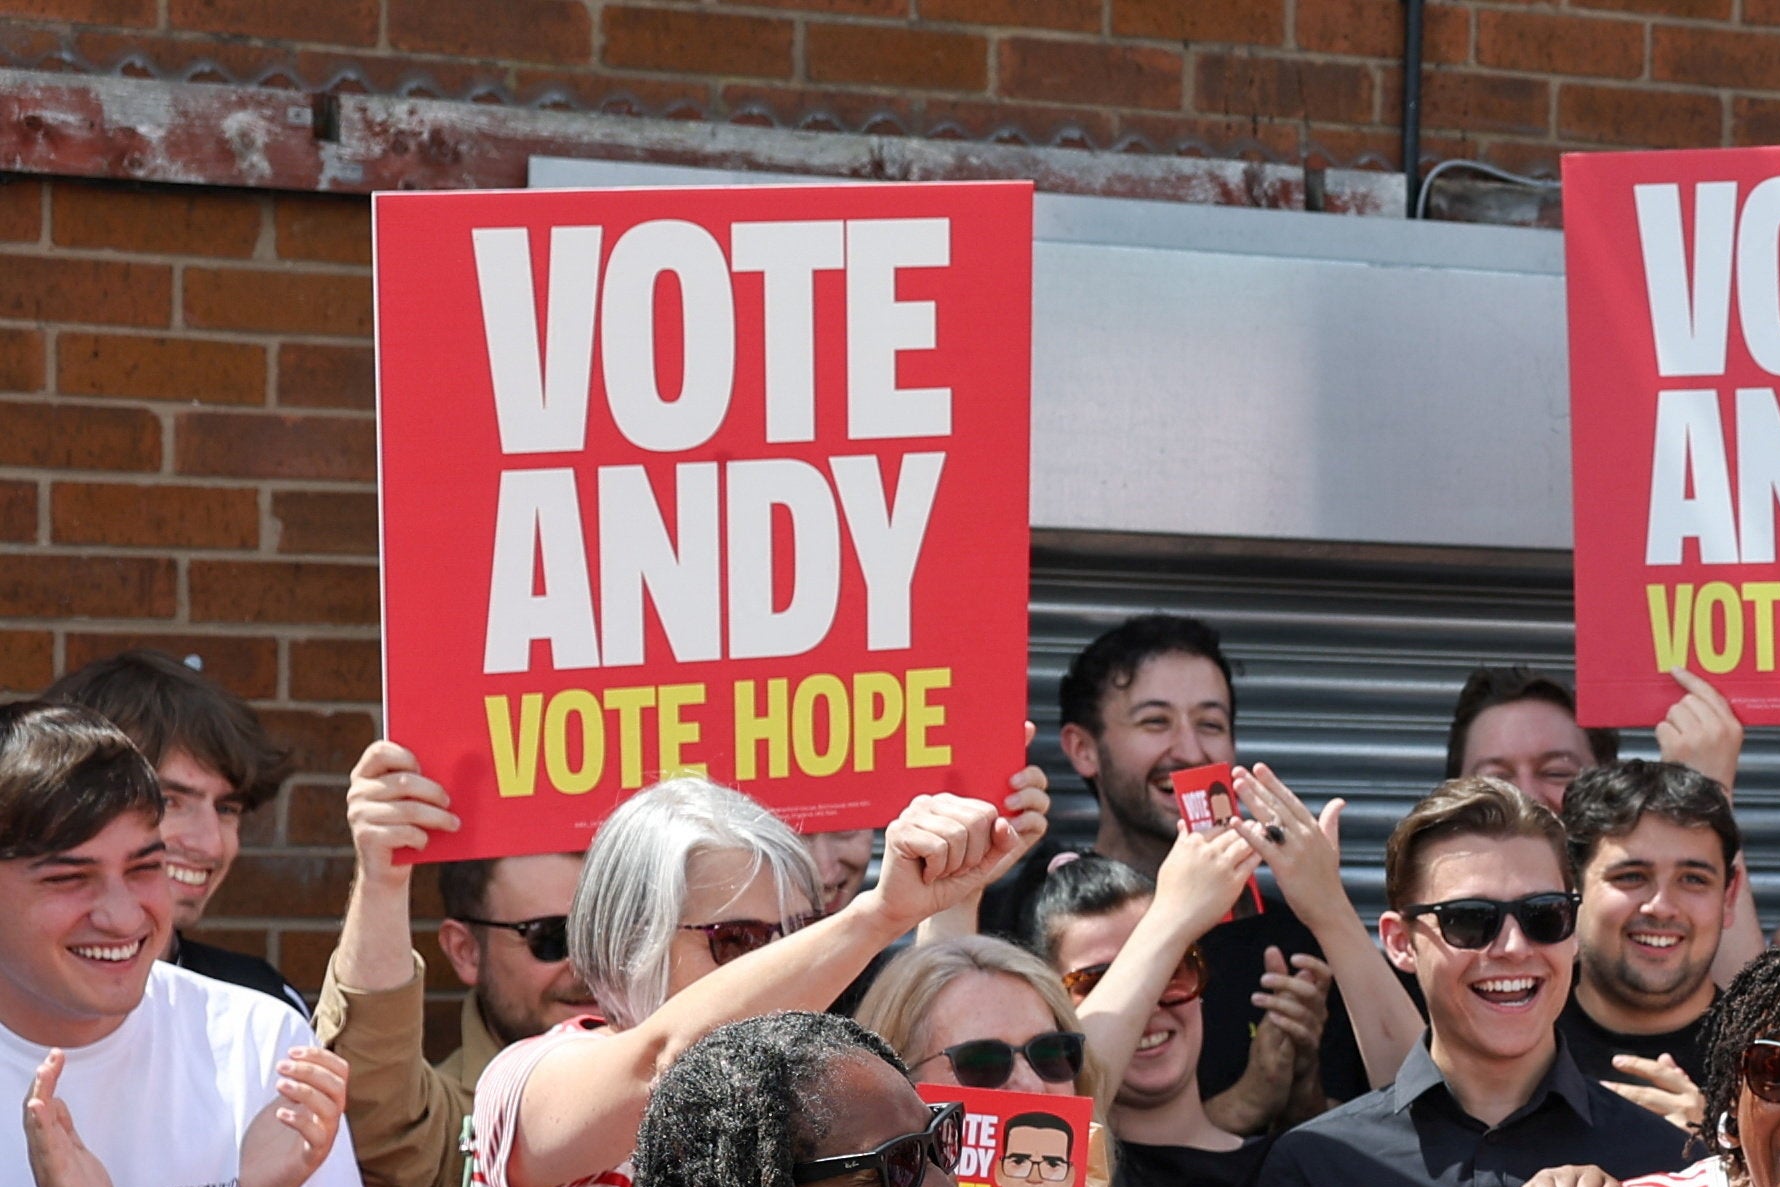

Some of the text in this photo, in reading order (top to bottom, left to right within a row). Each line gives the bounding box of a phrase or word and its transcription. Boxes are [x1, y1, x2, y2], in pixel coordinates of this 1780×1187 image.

[472, 217, 952, 455] VOTE
[483, 452, 946, 674] ANDY
[484, 668, 952, 797] VOTE HOPE
[957, 1147, 995, 1178] DY
[963, 1113, 999, 1147] TE
